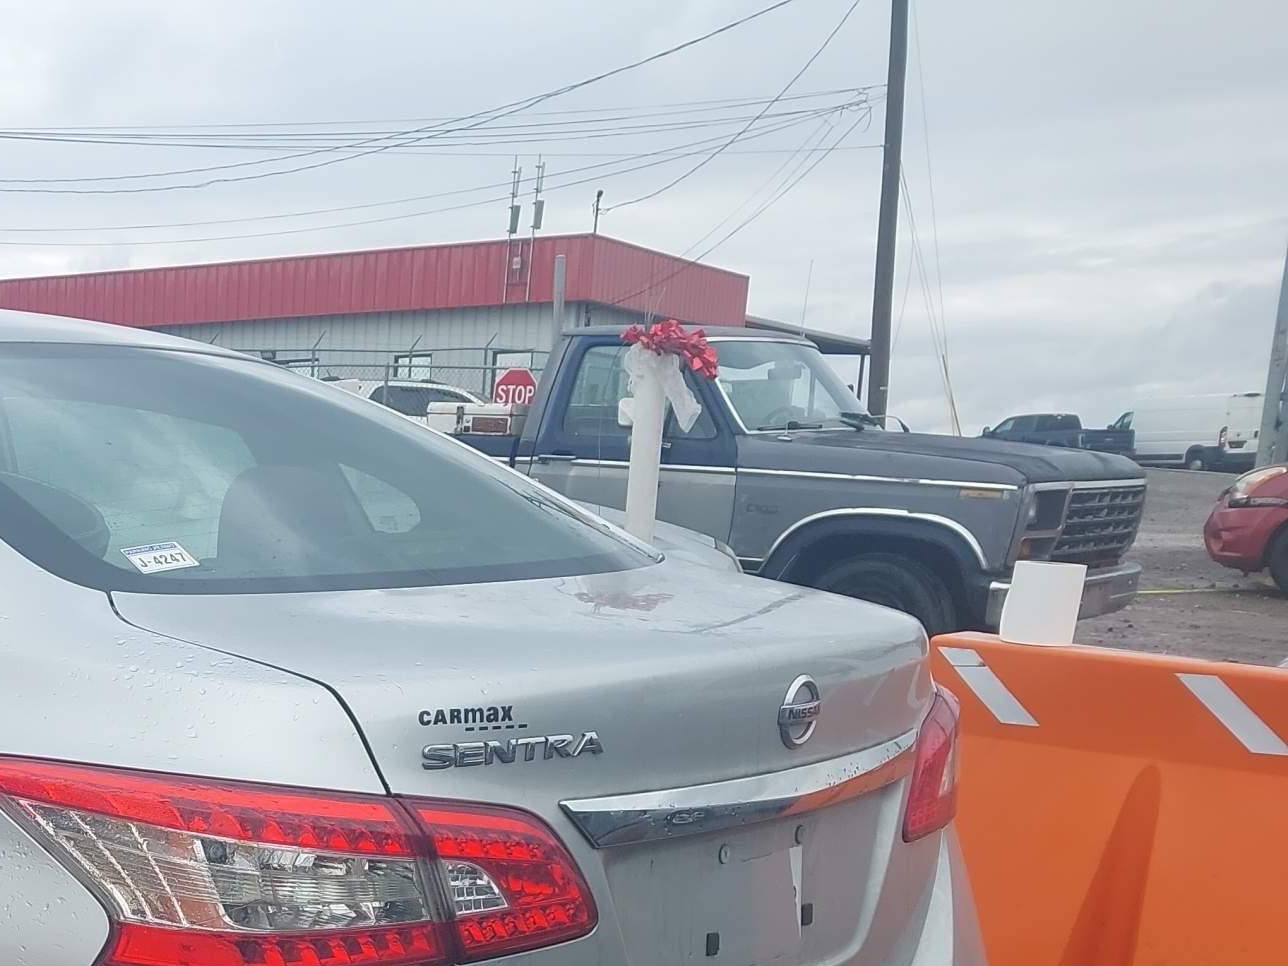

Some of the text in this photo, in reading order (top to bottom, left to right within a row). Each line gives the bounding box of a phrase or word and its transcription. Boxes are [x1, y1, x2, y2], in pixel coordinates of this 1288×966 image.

[496, 385, 535, 405] STOP
[137, 552, 187, 568] J-4247
[421, 730, 604, 770] SENTRA
